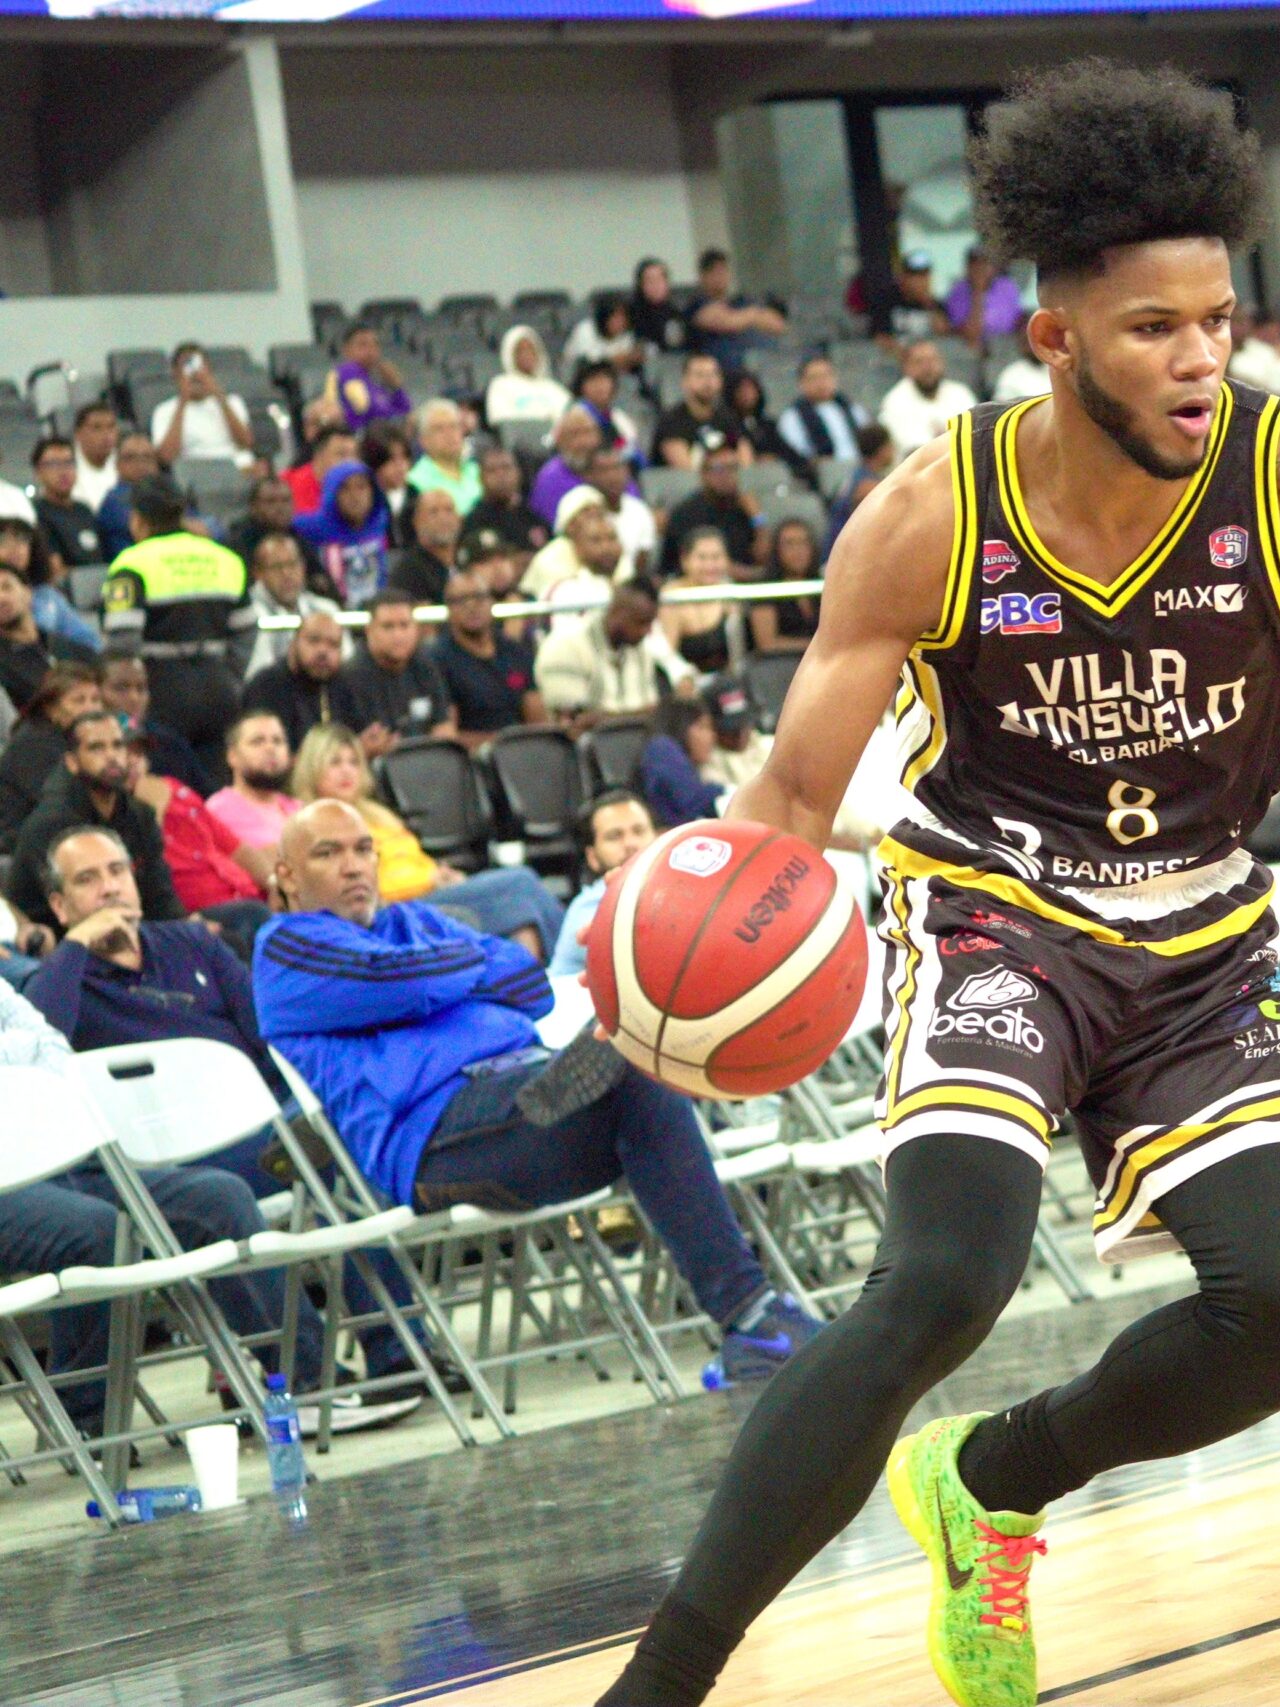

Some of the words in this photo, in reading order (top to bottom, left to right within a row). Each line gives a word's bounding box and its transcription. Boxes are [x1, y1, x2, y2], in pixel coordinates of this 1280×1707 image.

[982, 554, 1018, 566] ADINA
[980, 593, 1062, 632] GBC
[1154, 585, 1214, 616] MAX
[1024, 648, 1187, 704] VILLA
[1106, 779, 1159, 846] 8
[1052, 855, 1200, 885] BANRES
[733, 855, 810, 944] molten
[927, 1006, 1044, 1054] beato
